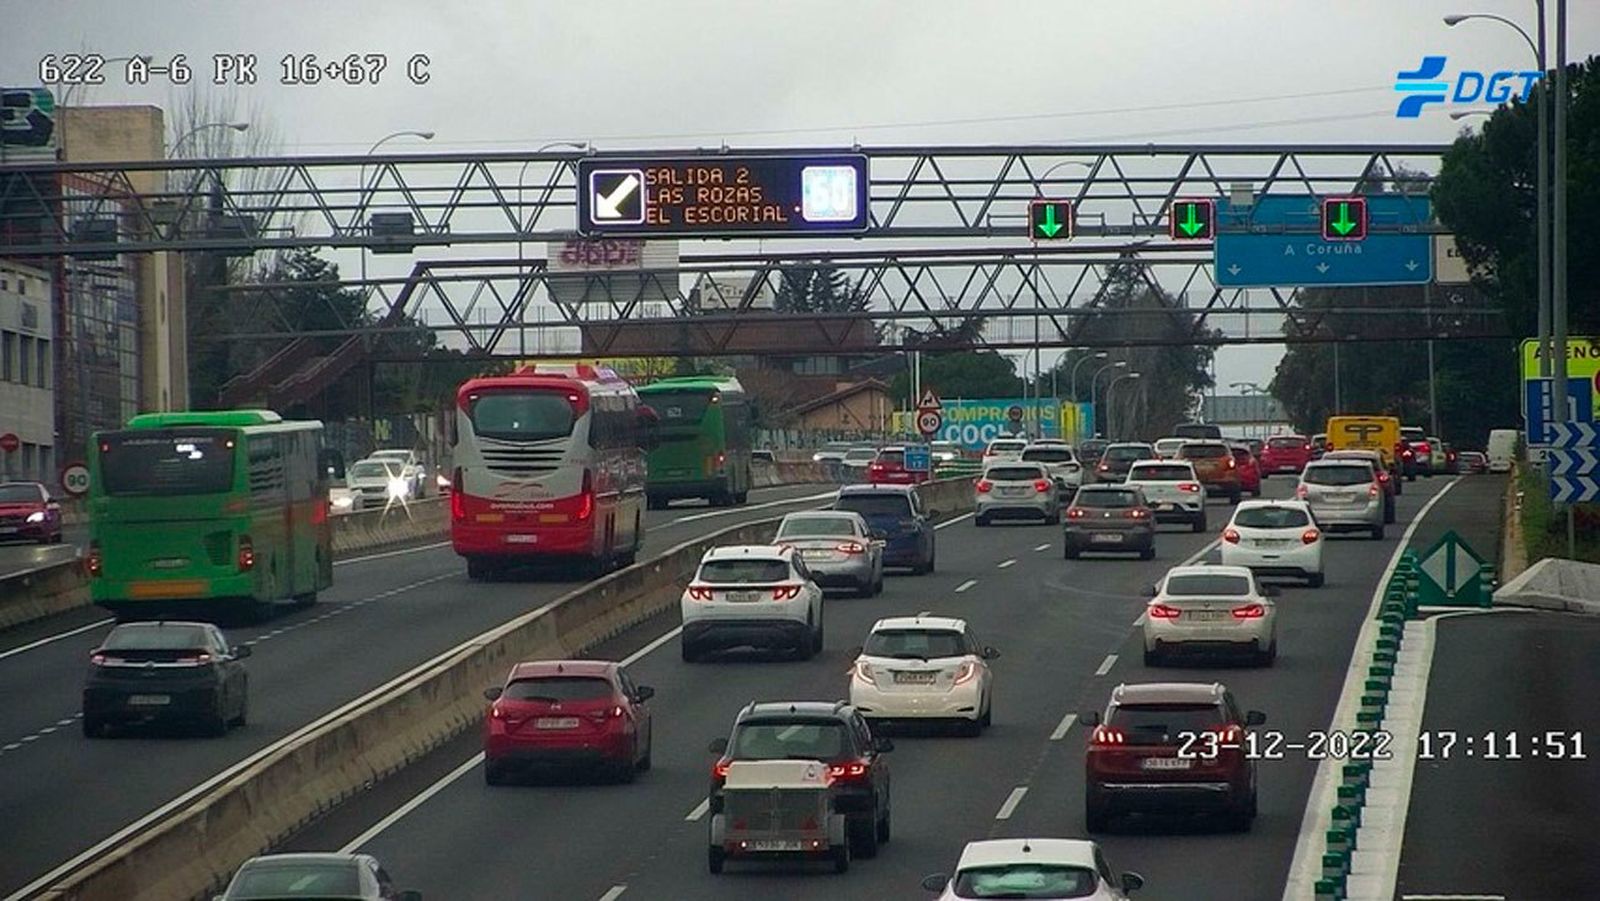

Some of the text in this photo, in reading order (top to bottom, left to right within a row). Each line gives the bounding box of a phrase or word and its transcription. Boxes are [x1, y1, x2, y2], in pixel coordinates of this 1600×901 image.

[646, 168, 749, 184] SALIDA 2
[646, 187, 763, 204] LAS ROZAS
[646, 207, 788, 224] EL ESCORIAL
[1284, 243, 1363, 256] A Coruña
[921, 416, 938, 427] 90
[68, 474, 87, 487] 90
